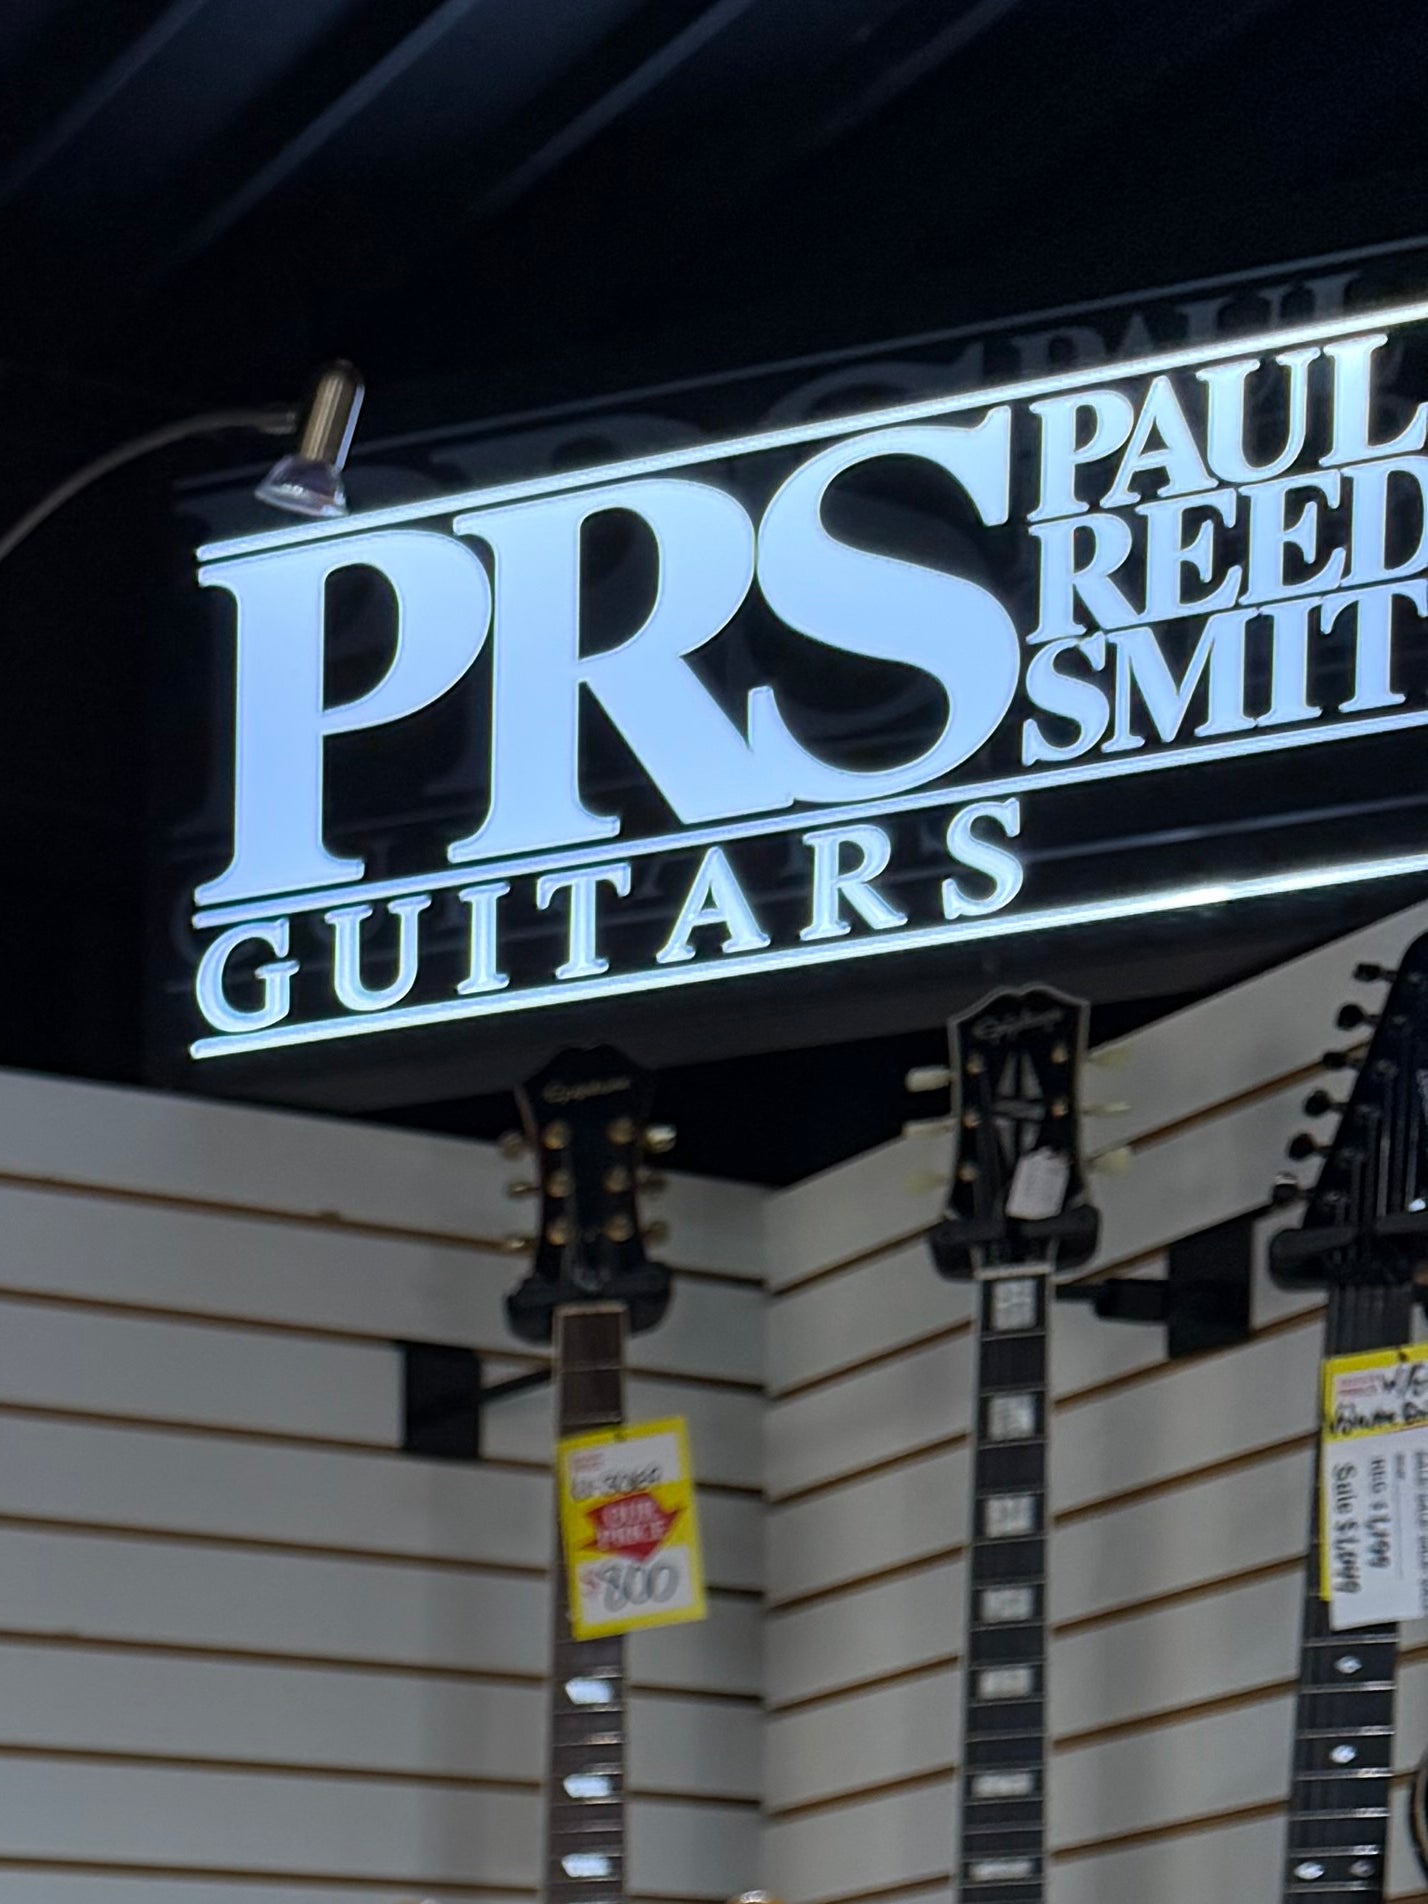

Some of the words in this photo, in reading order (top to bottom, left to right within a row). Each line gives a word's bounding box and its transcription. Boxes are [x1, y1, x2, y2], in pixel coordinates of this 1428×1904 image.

[1026, 333, 1428, 522] PAUL
[1025, 455, 1428, 646] REED
[194, 405, 1021, 910] PRS
[1021, 578, 1428, 767] SMIT
[194, 799, 1023, 1035] GUITARS
